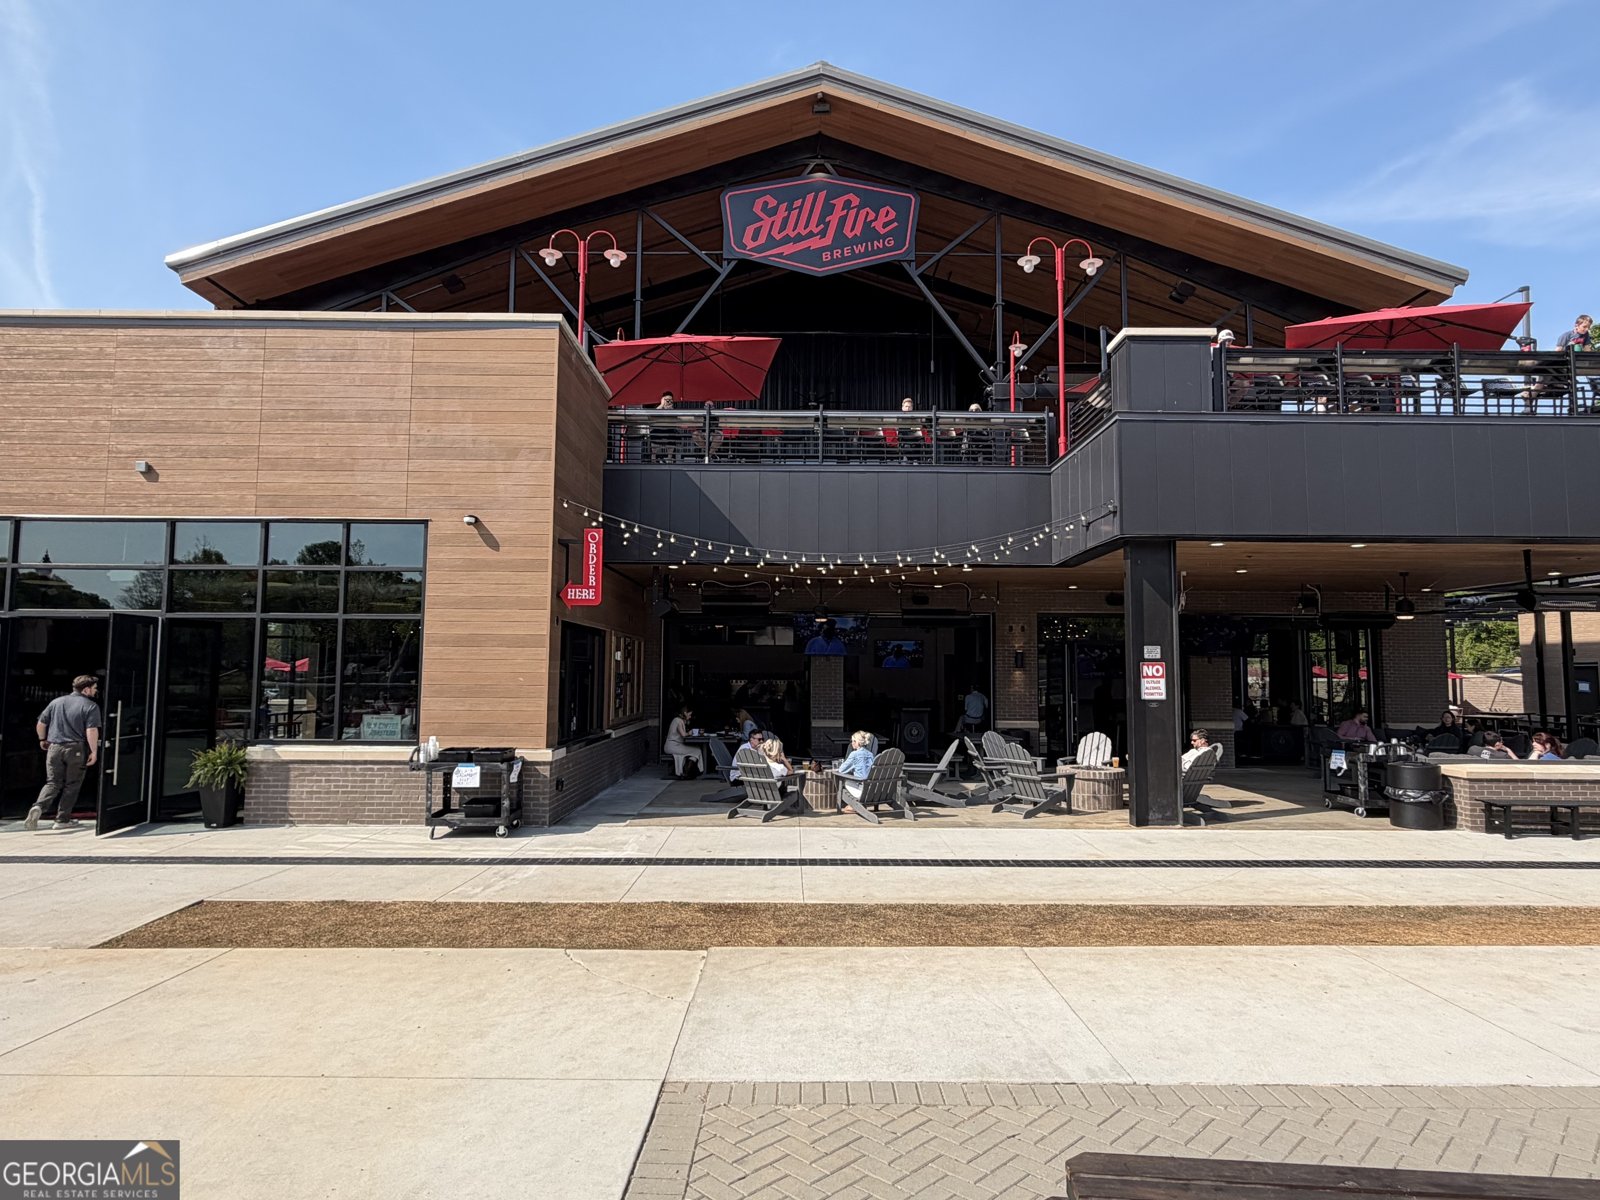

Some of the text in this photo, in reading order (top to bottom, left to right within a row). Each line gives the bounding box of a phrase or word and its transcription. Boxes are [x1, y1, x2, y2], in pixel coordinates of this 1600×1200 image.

[822, 237, 895, 262] BREWING
[587, 532, 599, 586] ORDER
[567, 588, 596, 600] HERE
[1142, 665, 1163, 677] NO
